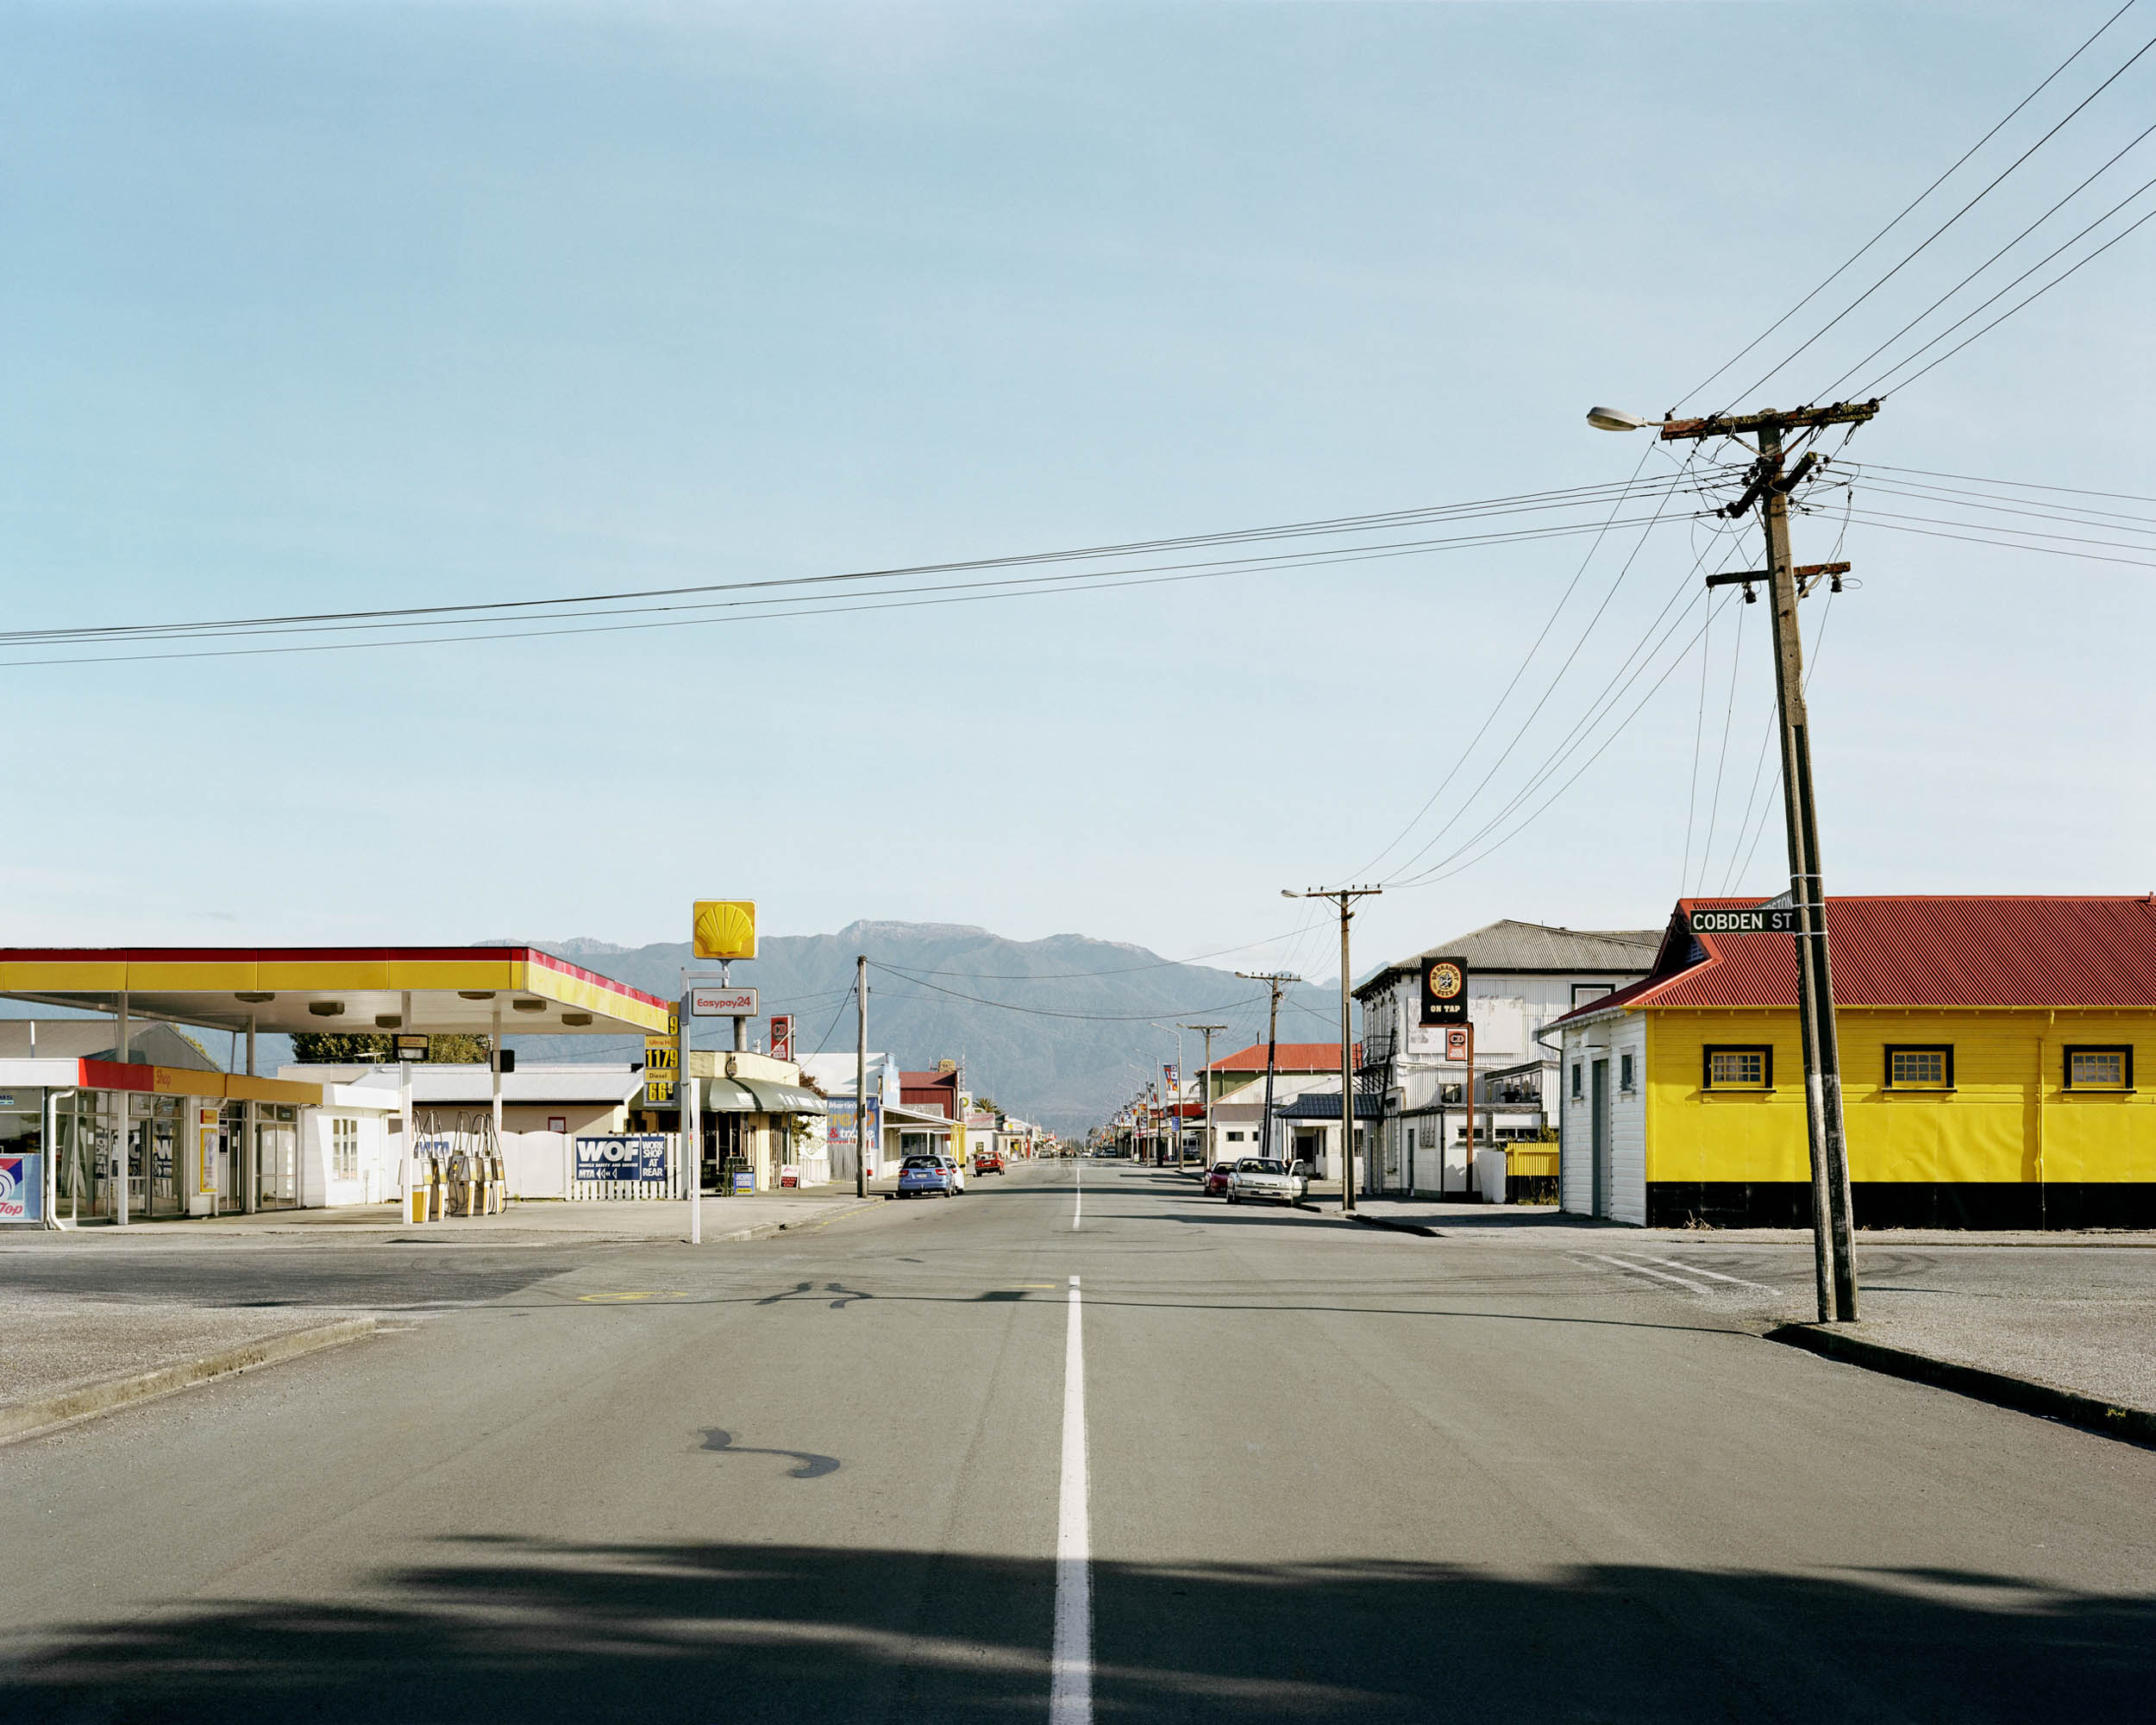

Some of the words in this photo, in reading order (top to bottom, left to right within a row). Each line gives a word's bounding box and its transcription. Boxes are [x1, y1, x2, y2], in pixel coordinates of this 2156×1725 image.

[1693, 913, 1763, 930] COBDEN
[1771, 913, 1793, 929] ST
[697, 996, 751, 1009] Easypay24
[156, 1070, 172, 1088] Shop
[829, 1127, 839, 1138] &
[642, 1141, 664, 1150] WORK
[577, 1141, 640, 1162] WOF
[642, 1150, 663, 1158] SHOP
[649, 1158, 658, 1167] AT
[578, 1169, 595, 1179] MTA
[642, 1168, 663, 1176] REAR
